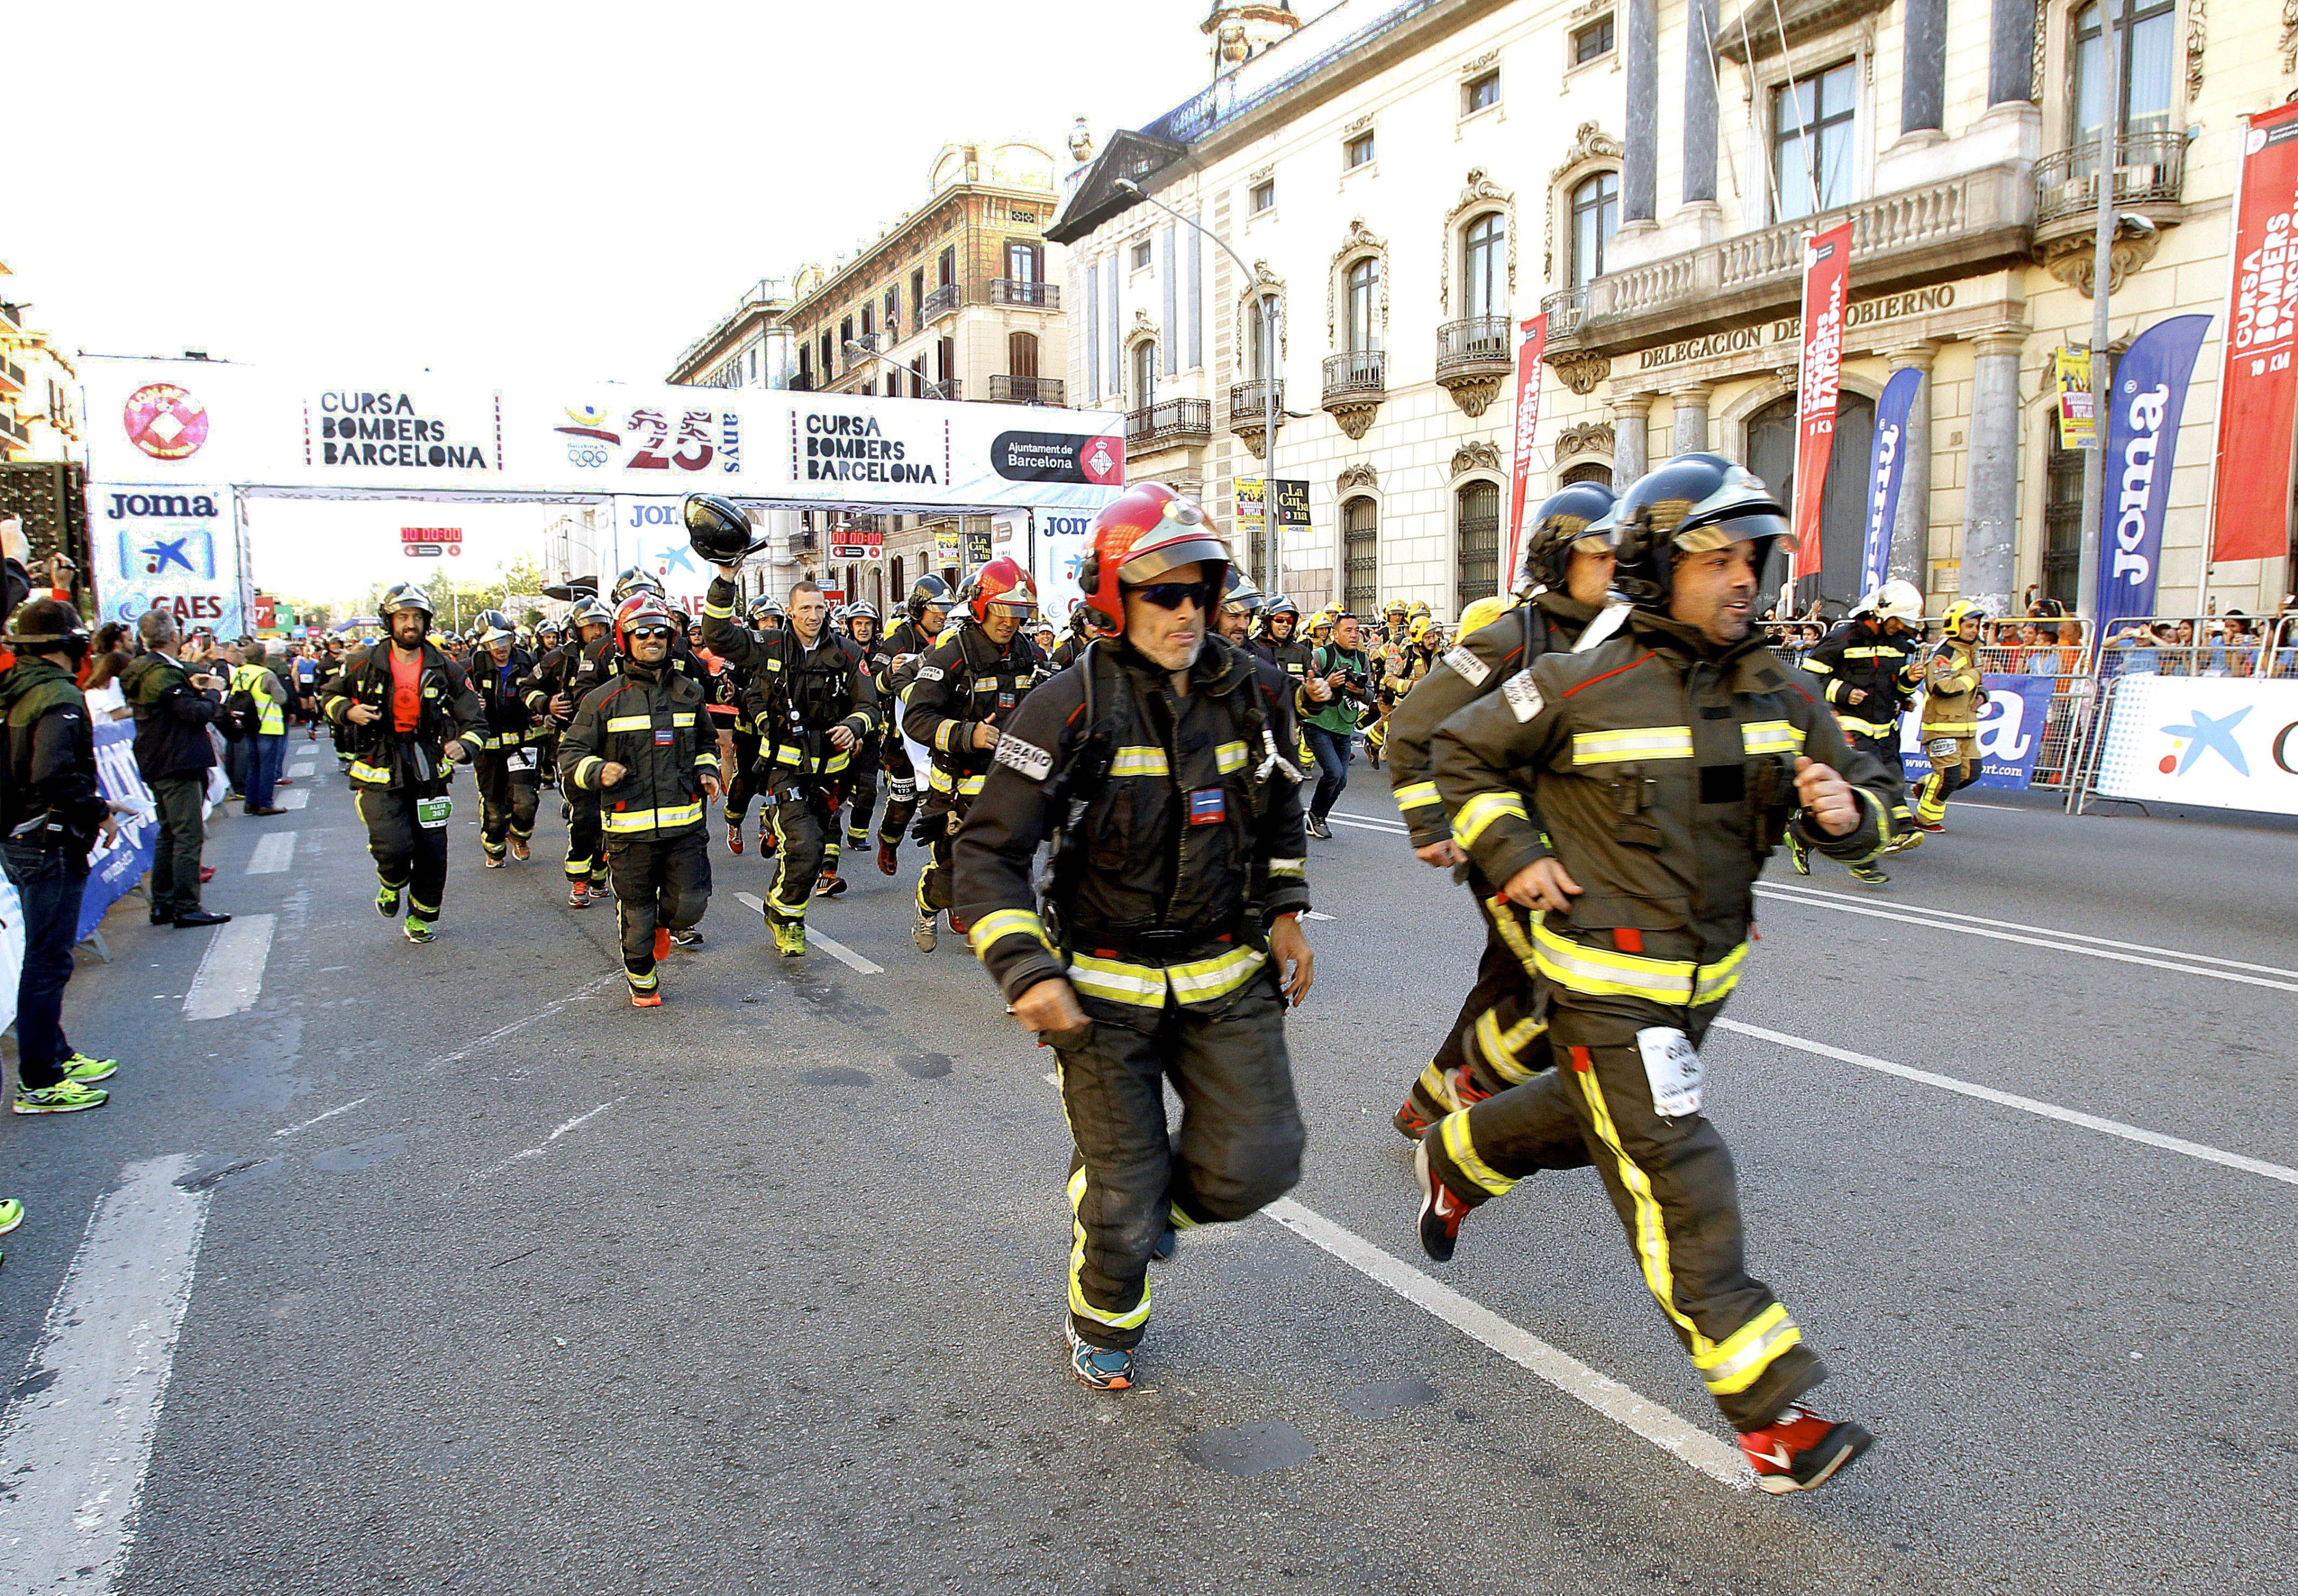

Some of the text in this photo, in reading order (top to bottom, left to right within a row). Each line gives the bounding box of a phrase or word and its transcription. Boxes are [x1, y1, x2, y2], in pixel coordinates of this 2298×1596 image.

[2253, 213, 2290, 345] BOMBERS
[2236, 248, 2262, 349] CURSA
[1640, 325, 1763, 369] DELEGACION
[1845, 284, 1955, 326] OBIERNO
[1820, 273, 1842, 408] BARCELONA
[1812, 312, 1829, 412] BOMBERS
[2251, 352, 2291, 377] 10 KM
[1803, 339, 1816, 415] CURSA
[321, 392, 415, 415] CURSA
[322, 417, 445, 442] BOMBERS
[806, 414, 882, 437] CURSA
[626, 408, 740, 473] 25 anys
[807, 437, 905, 460] BOMBERS
[1008, 442, 1073, 454] Ajuntament de
[323, 442, 487, 468] BARCELONA
[1008, 453, 1073, 469] Barcelona
[808, 460, 937, 484] BARCELONA
[1287, 483, 1303, 497] La
[974, 535, 987, 544] La
